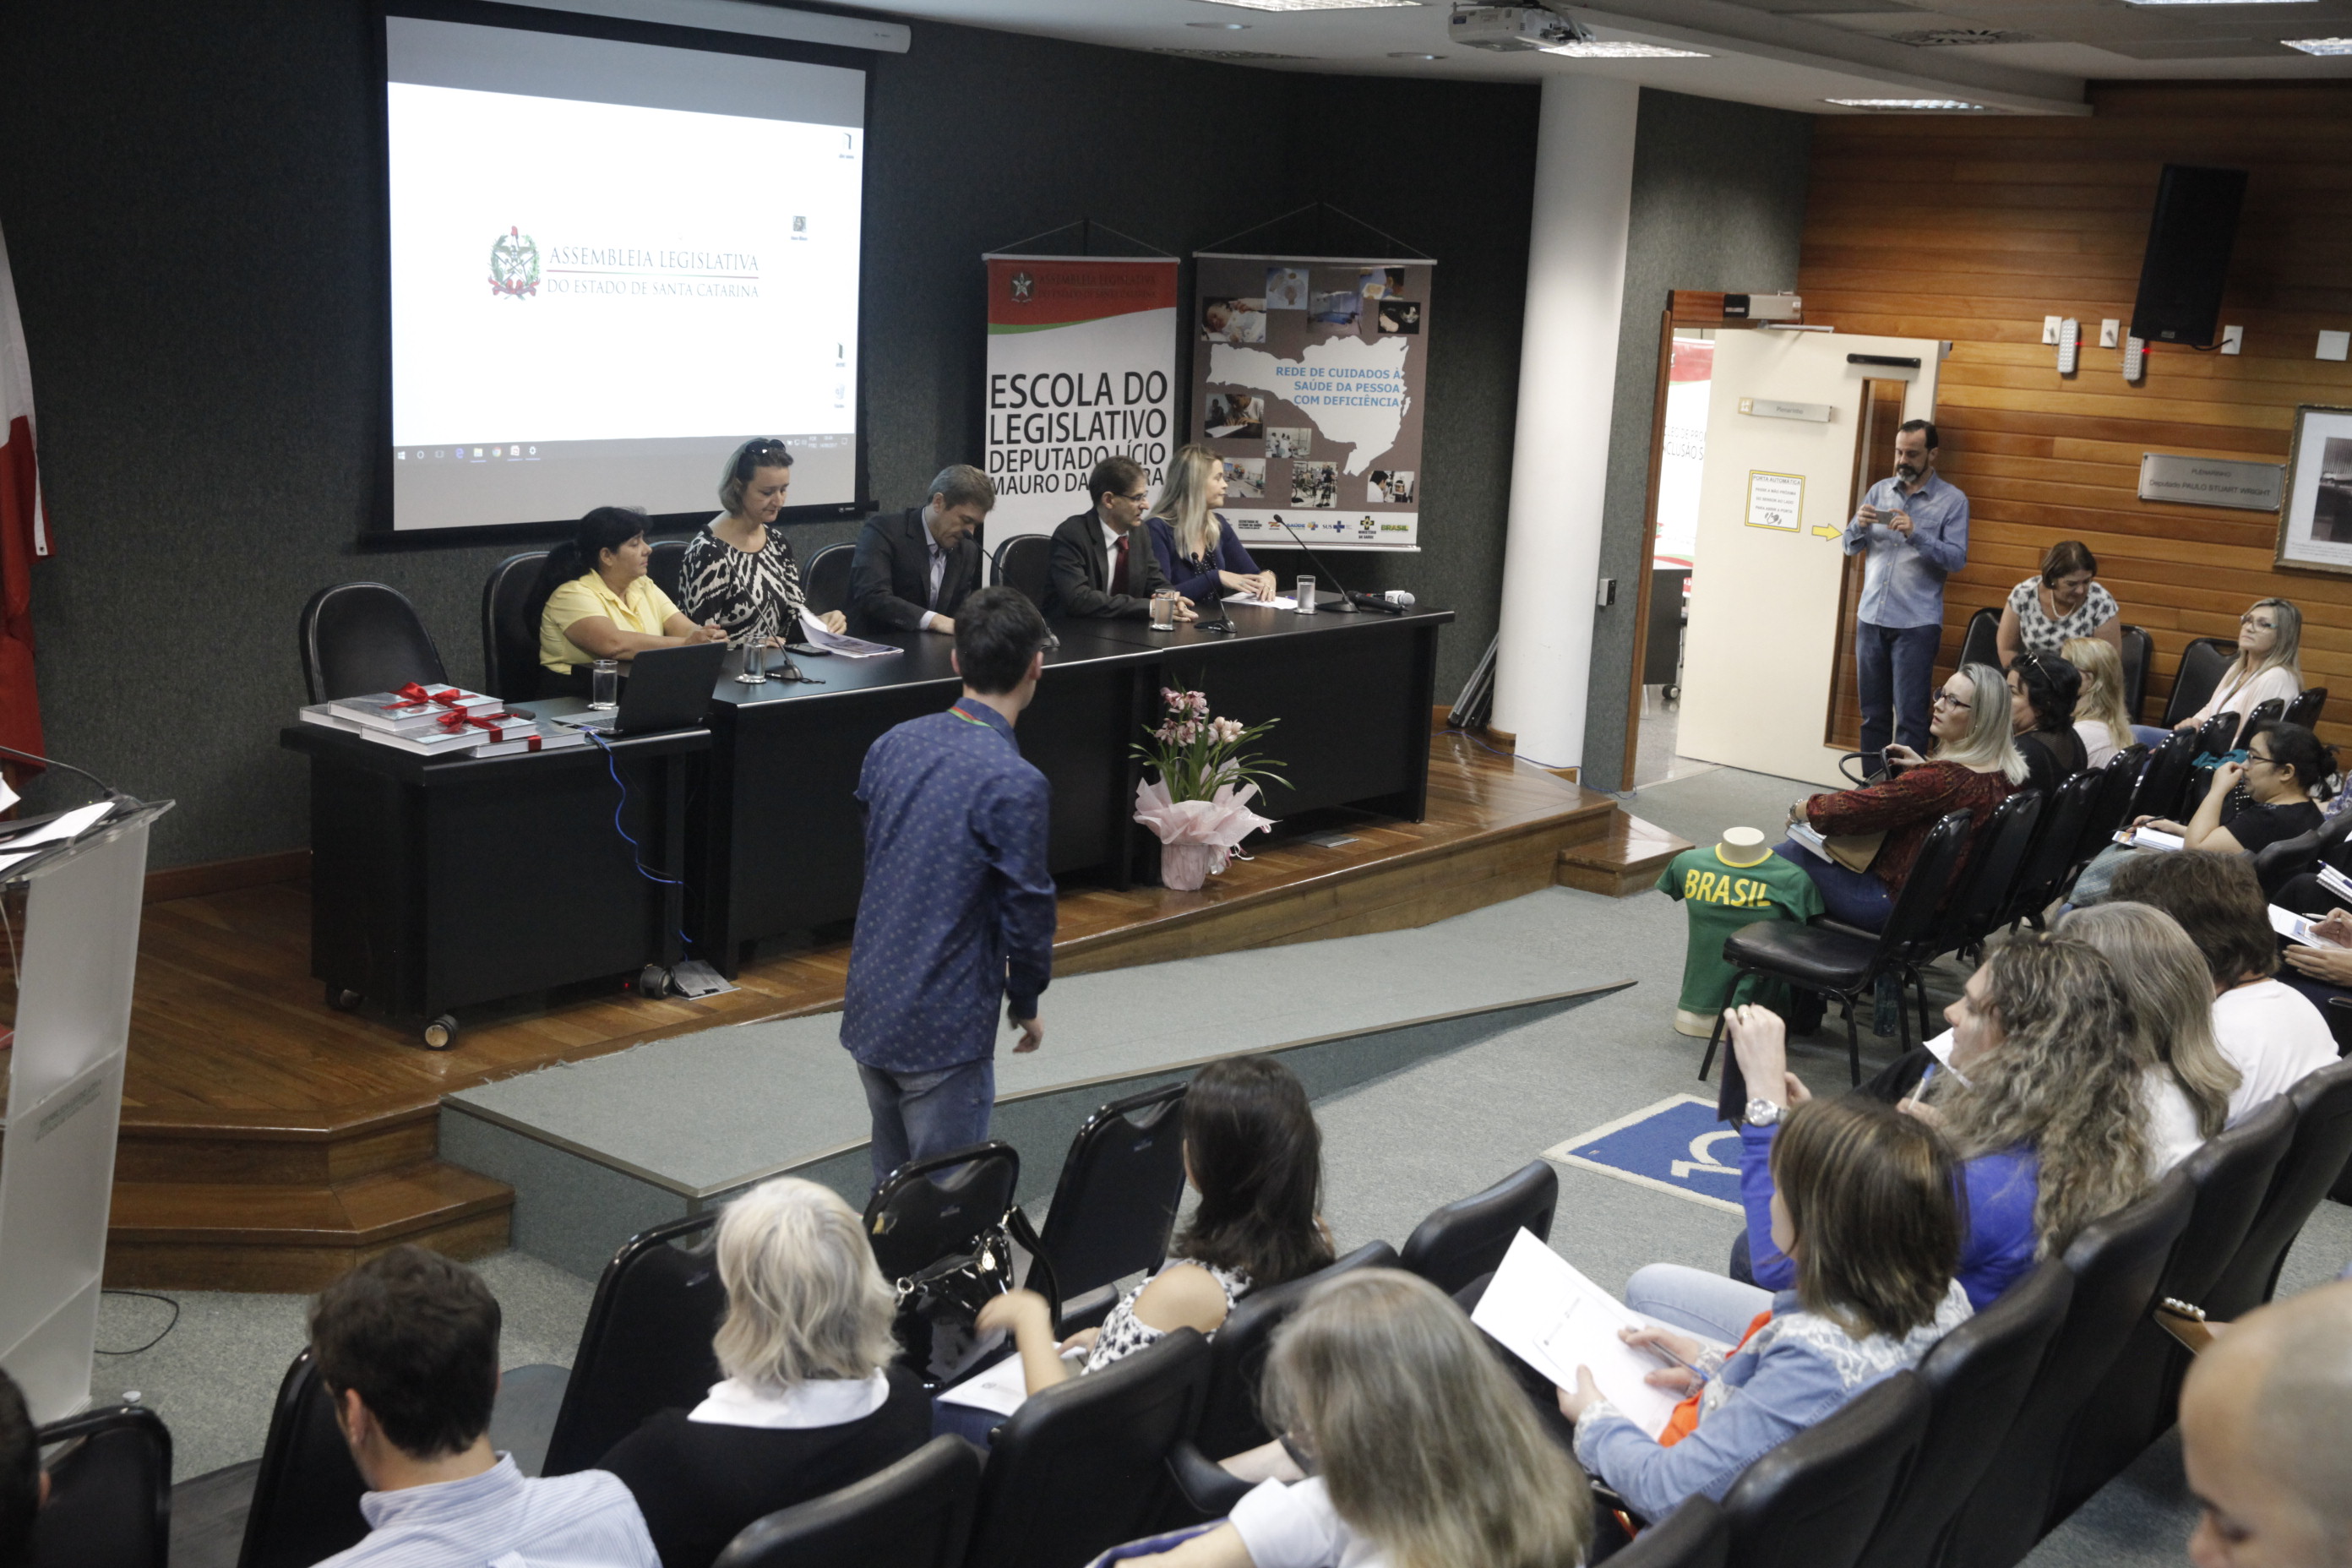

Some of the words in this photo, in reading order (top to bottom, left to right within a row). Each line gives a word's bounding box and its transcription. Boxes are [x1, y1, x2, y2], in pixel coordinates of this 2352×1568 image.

[549, 247, 653, 267] ASSEMBLEIA
[660, 251, 759, 270] LEGISLATIVA
[547, 279, 569, 293] DO
[574, 280, 626, 294] ESTADO
[631, 281, 647, 295] DE
[652, 282, 693, 296] SANTA
[697, 283, 759, 297] CATARINA
[1277, 367, 1306, 377] REDE
[1310, 368, 1326, 378] DE
[1328, 368, 1390, 378] CUIDADOS
[991, 373, 1113, 409] ESCOLA
[1124, 370, 1168, 406] DO
[1294, 378, 1332, 391] SAÚDE
[1337, 383, 1353, 392] DA
[1356, 384, 1400, 393] PESSOA
[1293, 395, 1320, 405] COM
[1324, 395, 1399, 406] DEFICIÊNCIA
[990, 408, 1167, 445] LEGISLATIVO
[989, 446, 1109, 474] DEPUTADO
[991, 474, 1059, 495] MAURO
[2149, 479, 2180, 489] Deputado
[2182, 482, 2207, 491] PAULO
[2208, 485, 2238, 493] STUART
[2240, 488, 2270, 497] WRIGHT
[1684, 868, 1772, 907] BRASIL
